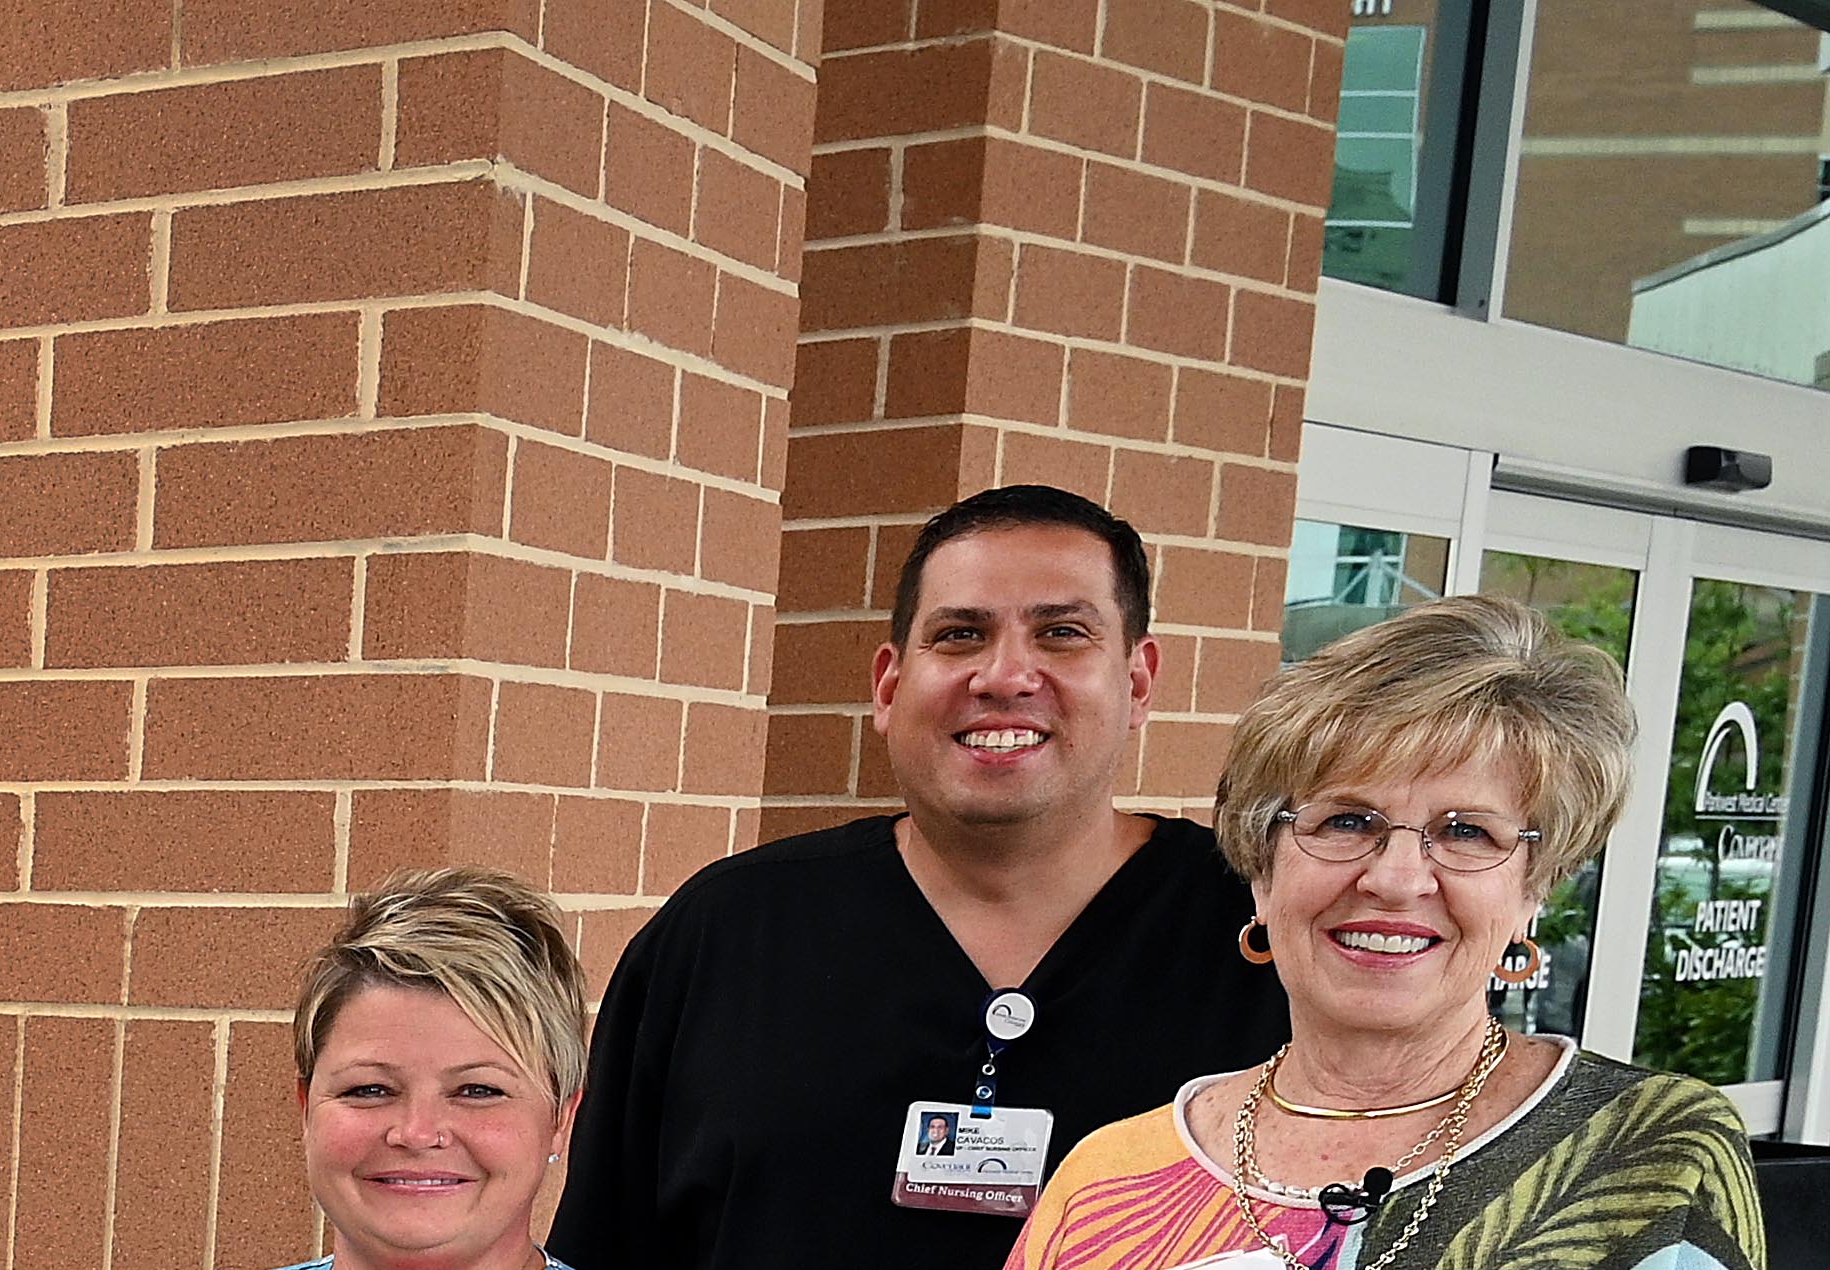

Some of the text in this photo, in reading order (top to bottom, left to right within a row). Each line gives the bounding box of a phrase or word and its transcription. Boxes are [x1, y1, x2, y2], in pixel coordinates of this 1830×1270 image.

[1694, 899, 1762, 933] PATIENT
[1675, 946, 1766, 982] DISCHARGE
[957, 1136, 1005, 1144] CAVACOS
[905, 1183, 1023, 1203] Chief Nursing Officer
